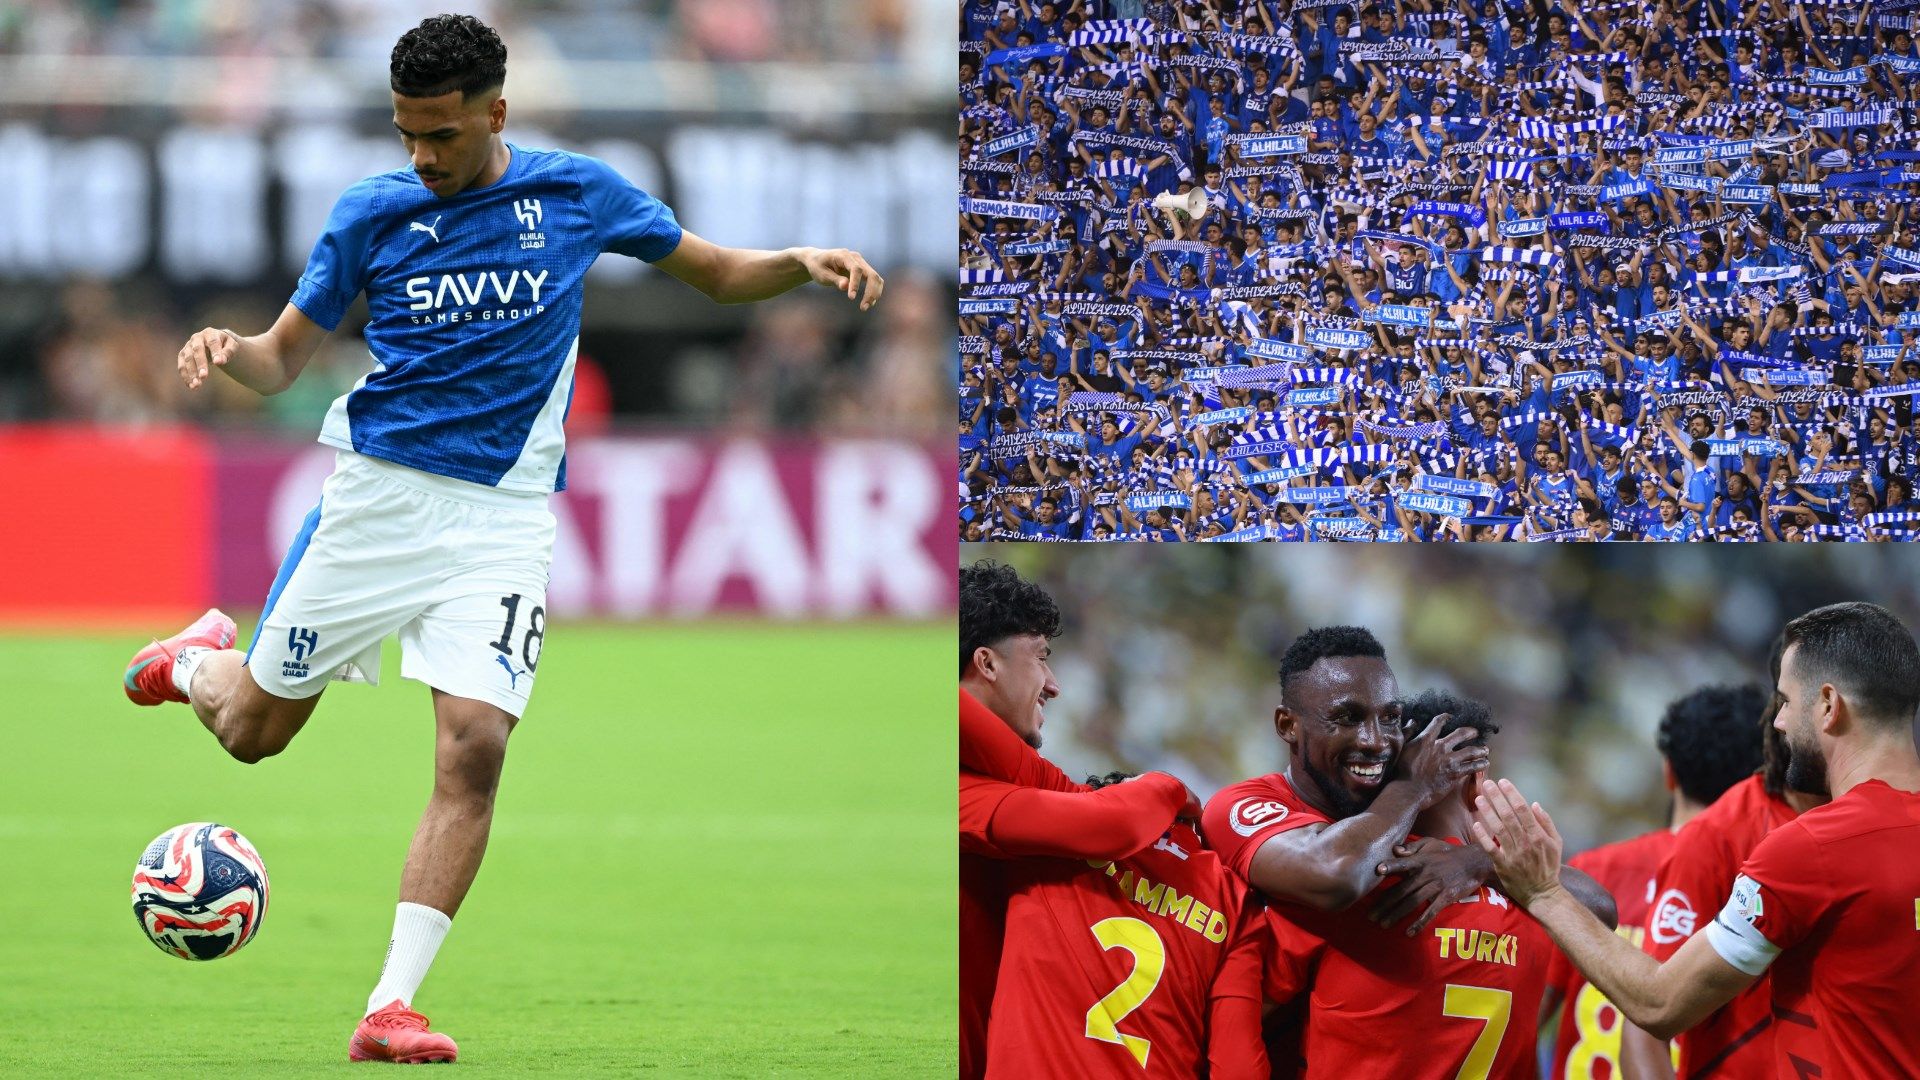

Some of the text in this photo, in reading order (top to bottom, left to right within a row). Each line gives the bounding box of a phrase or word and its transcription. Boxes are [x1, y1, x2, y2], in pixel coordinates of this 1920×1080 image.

[1815, 70, 1859, 84] ALHILAL
[1832, 109, 1878, 128] ALHILAL
[1250, 139, 1295, 152] ALHILAL
[1719, 143, 1754, 158] ALHIL
[1661, 151, 1697, 163] ALHILAL
[1606, 181, 1648, 199] ALHILAL
[1668, 174, 1709, 190] ALHILAL
[1791, 183, 1822, 194] ALHIL
[1559, 214, 1585, 226] HILAL
[1819, 222, 1881, 235] BLUE POWER
[1893, 247, 1920, 262] ALHI
[406, 269, 549, 311] SAVVY
[972, 281, 1030, 297] BLUE POWER
[410, 304, 545, 325] GAMES GROUP
[1383, 307, 1420, 323] ALHILAL
[1315, 331, 1361, 347] ALHILAL
[1258, 342, 1299, 360] ALHILAL
[1293, 388, 1332, 403] ALHILAL
[1196, 407, 1242, 423] ALHILAL
[1253, 467, 1301, 485] ALHILAL
[1795, 470, 1852, 485] BLUE POWER
[1132, 493, 1185, 508] ALHILAL
[1408, 496, 1455, 513] ALHILAL
[488, 592, 545, 674] 18
[1434, 926, 1518, 967] TURKI
[1084, 915, 1166, 1070] 2
[1442, 983, 1513, 1080] 7
